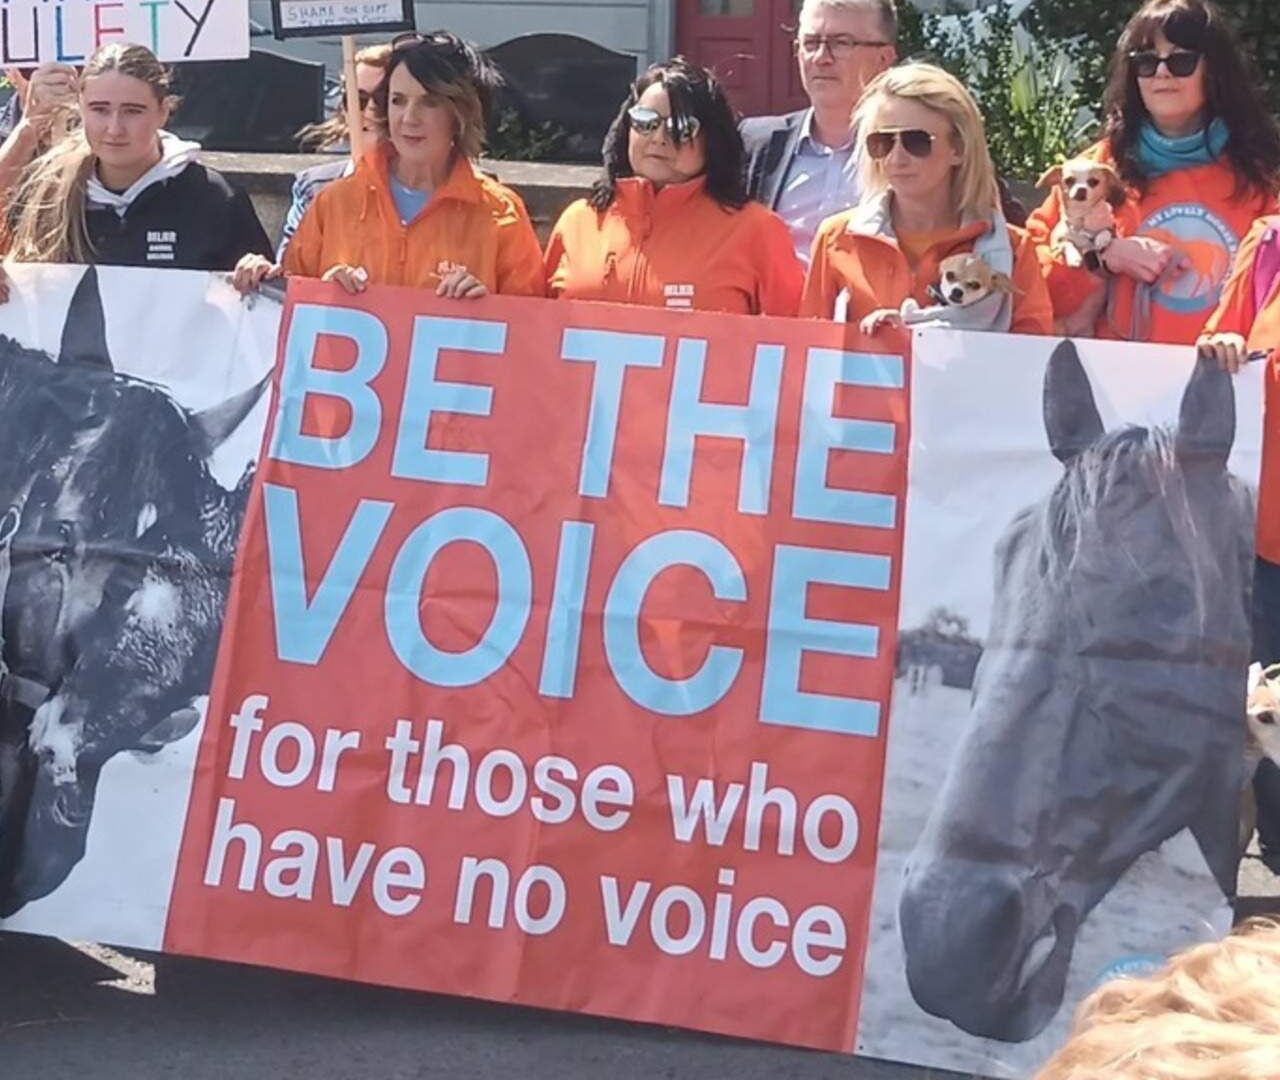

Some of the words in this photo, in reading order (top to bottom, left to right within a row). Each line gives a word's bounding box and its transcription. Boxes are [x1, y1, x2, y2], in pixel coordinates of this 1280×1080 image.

[270, 303, 508, 487] BE
[561, 327, 905, 529] THE
[263, 482, 892, 737] VOICE
[228, 695, 360, 793] for
[386, 719, 635, 832] those
[667, 762, 860, 864] who
[203, 798, 426, 917] have
[453, 854, 567, 935] no
[600, 869, 848, 977] voice
